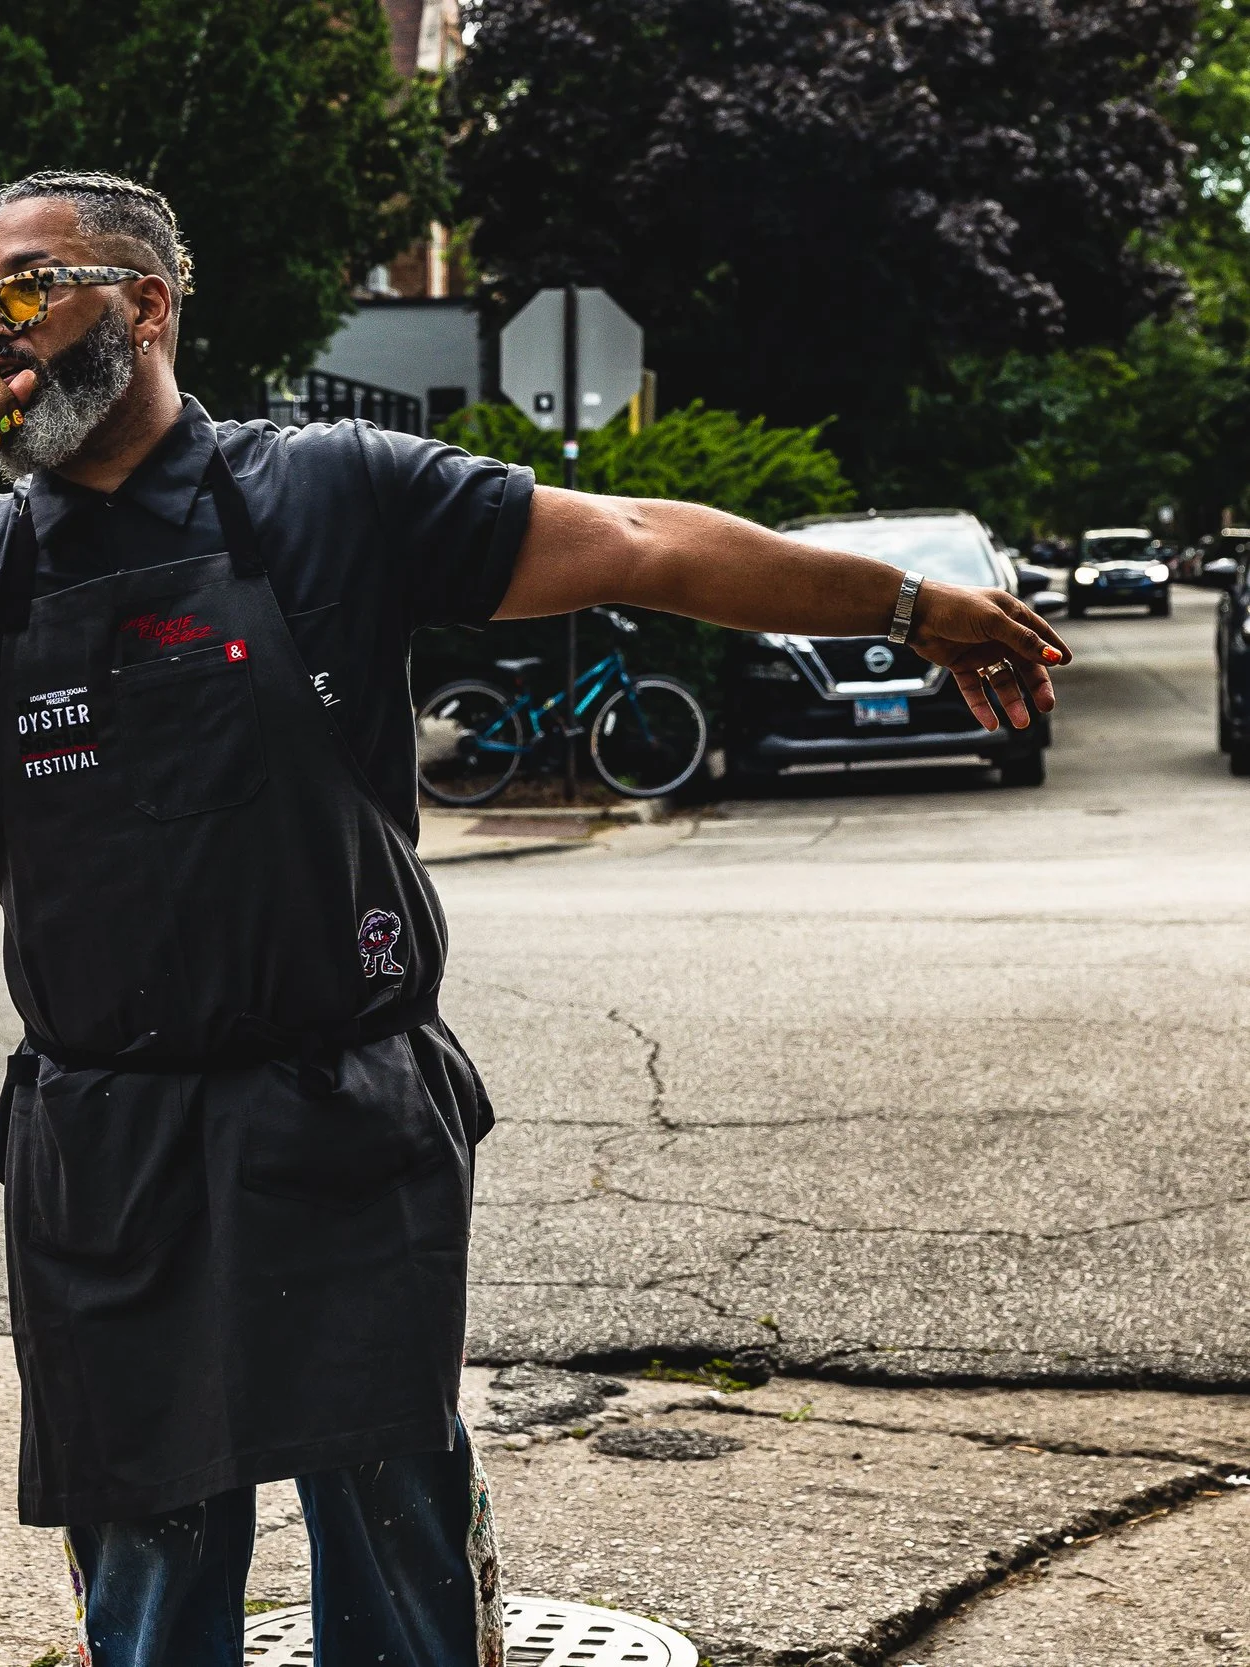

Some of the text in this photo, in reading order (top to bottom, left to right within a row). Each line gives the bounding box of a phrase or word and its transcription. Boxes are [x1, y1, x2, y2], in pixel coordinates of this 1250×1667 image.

[230, 644, 243, 659] &
[29, 686, 88, 703] LOGAN OYSTER SOCIALS
[46, 696, 70, 706] PRESENTS
[18, 703, 91, 735] OYSTER
[25, 750, 99, 779] FESTIVAL
